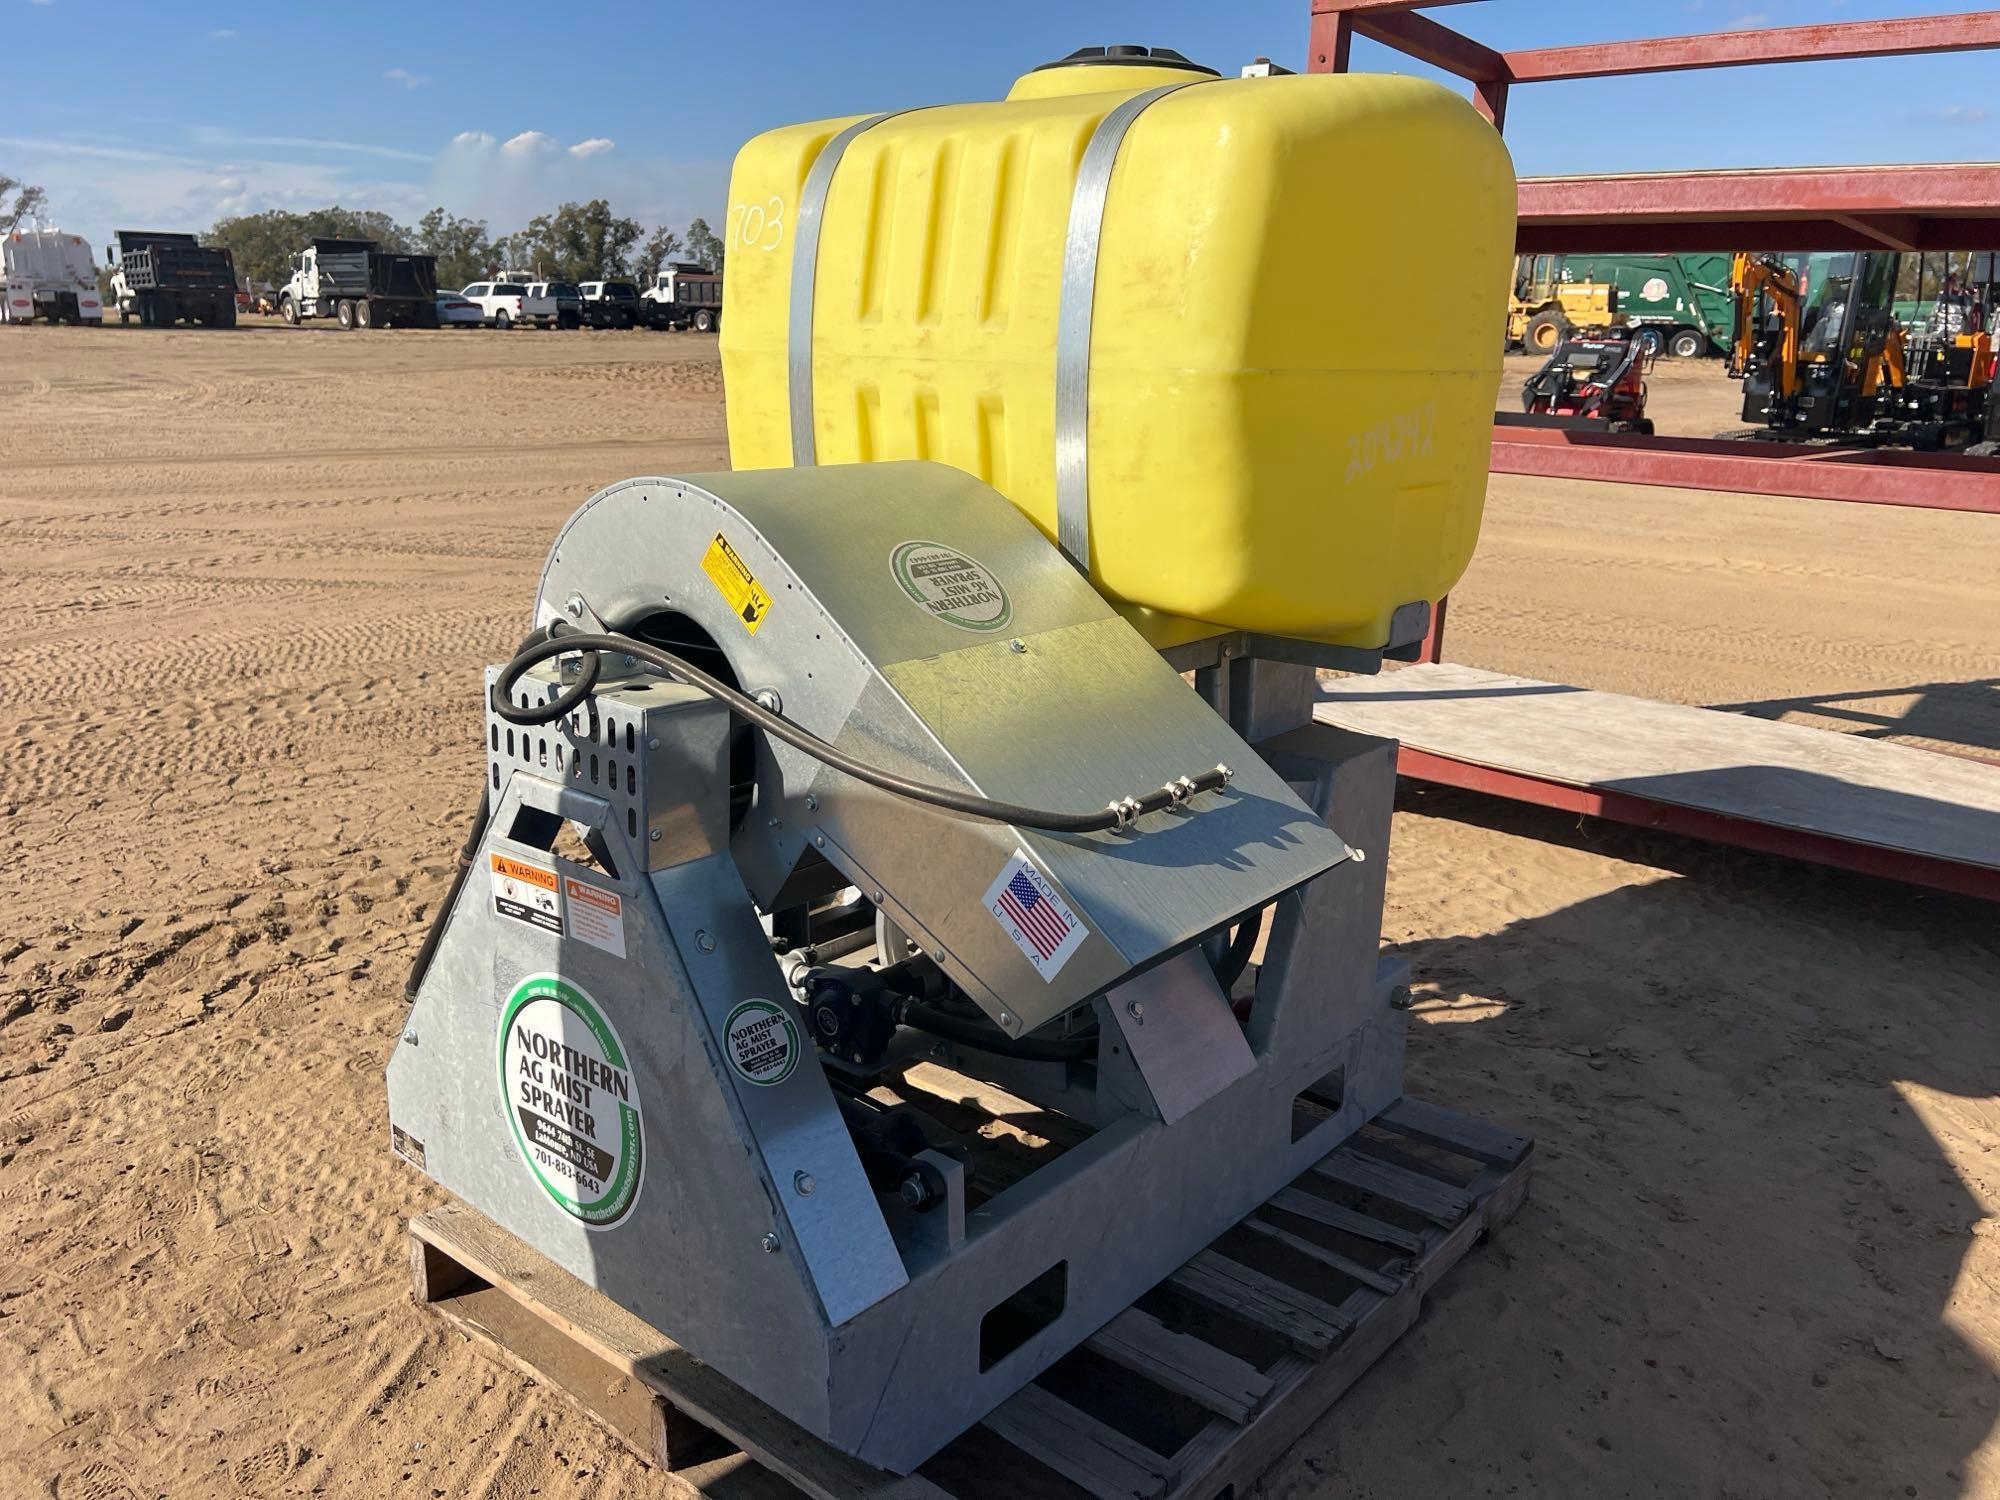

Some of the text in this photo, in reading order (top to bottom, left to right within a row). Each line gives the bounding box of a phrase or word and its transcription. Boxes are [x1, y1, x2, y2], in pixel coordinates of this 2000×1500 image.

[733, 196, 784, 252] 703
[724, 545, 751, 582] WARNING
[930, 570, 981, 587] SPRAYER
[941, 580, 990, 598] AG MIST
[926, 590, 1000, 613] NORTHERN
[510, 863, 555, 888] WARNING
[578, 885, 617, 906] WARNING
[1021, 861, 1079, 929] MADE IN
[731, 1012, 786, 1042] NORTHERN
[736, 1029, 772, 1051] AG MIST
[738, 1038, 778, 1062] SPRAYER
[517, 1024, 629, 1102] NORTHERN
[519, 1055, 592, 1108] AG MIST
[521, 1082, 597, 1140] SPRAYER
[570, 1150, 582, 1164] ND
[583, 1157, 599, 1174] USA
[586, 1147, 596, 1160] SE
[535, 1148, 600, 1194] 701-883-6643
